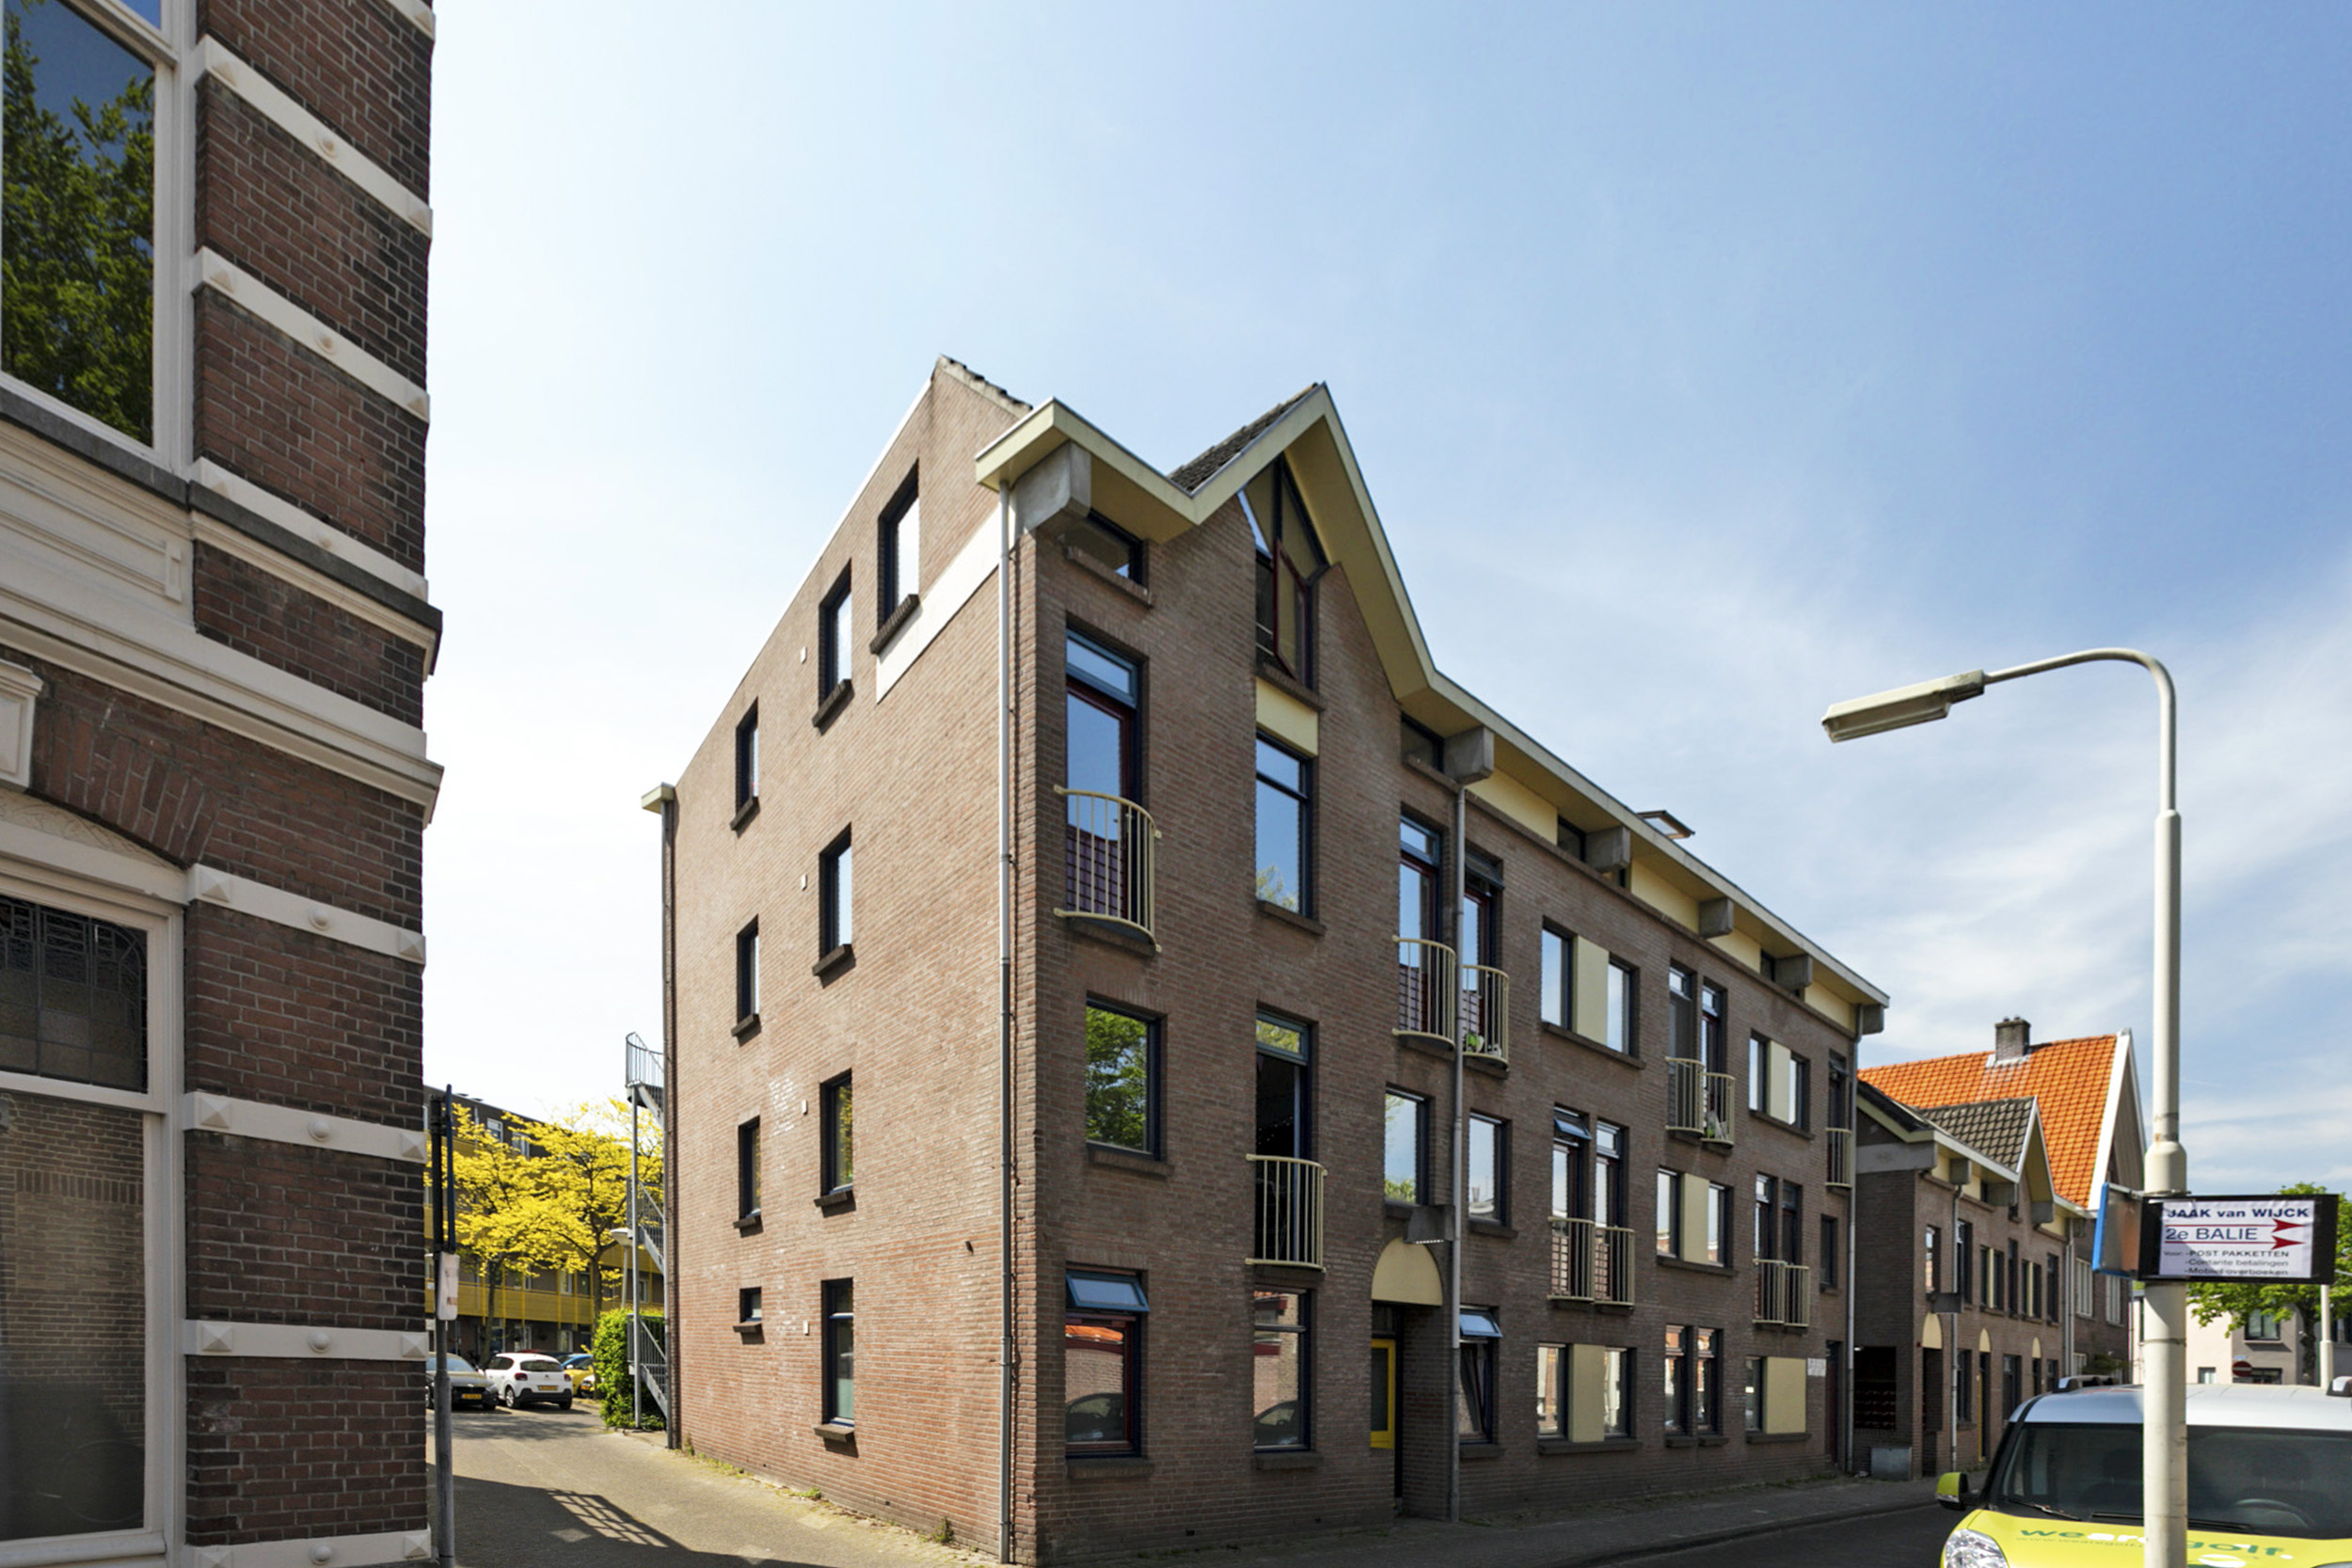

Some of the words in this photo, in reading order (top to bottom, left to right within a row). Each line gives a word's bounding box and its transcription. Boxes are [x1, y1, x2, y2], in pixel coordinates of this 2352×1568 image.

[2167, 1208, 2211, 1218] JAAK
[2251, 1208, 2310, 1217] WIJCK
[2166, 1227, 2189, 1240] 2e
[2196, 1227, 2258, 1240] BALIE
